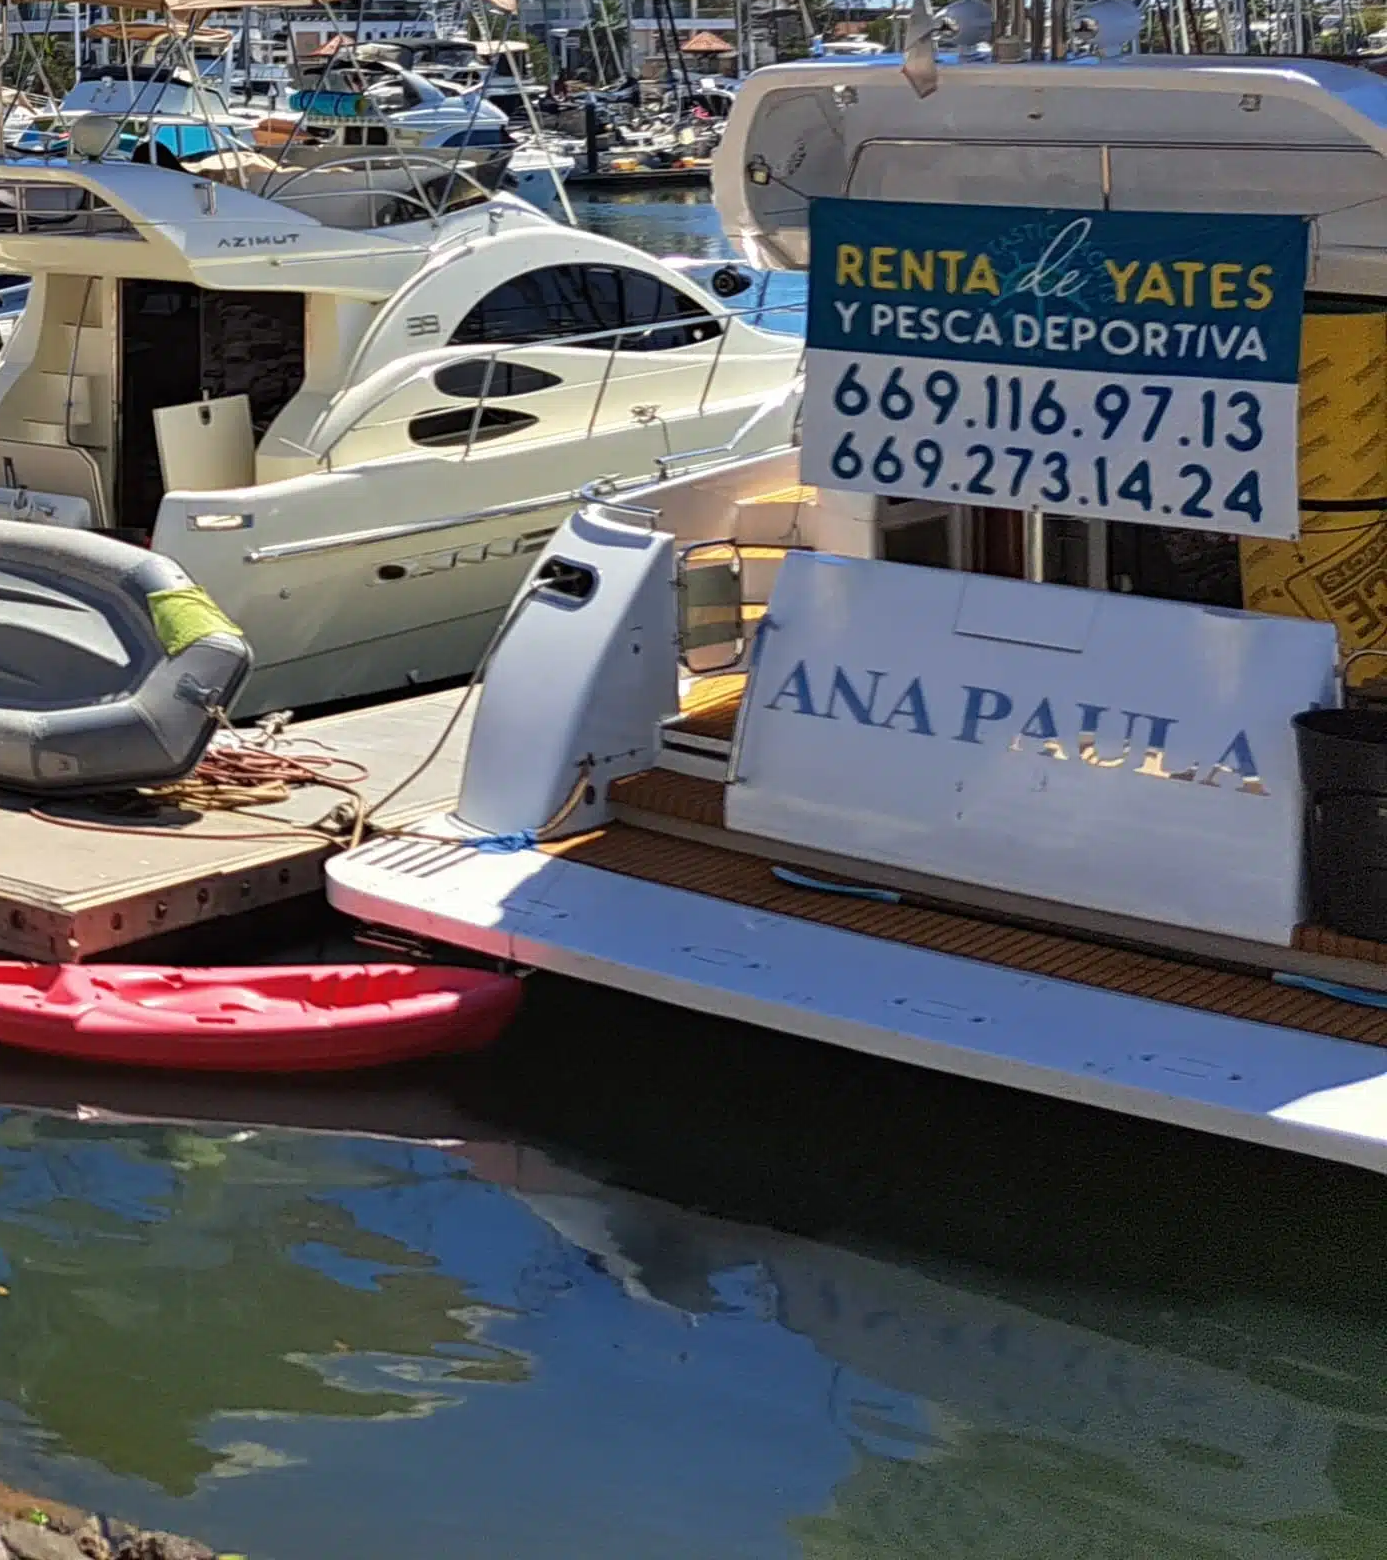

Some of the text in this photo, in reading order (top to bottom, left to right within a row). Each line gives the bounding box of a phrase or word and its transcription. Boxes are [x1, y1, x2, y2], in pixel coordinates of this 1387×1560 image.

[217, 233, 300, 249] AZIMUT
[836, 244, 1000, 297] RENTA
[1015, 216, 1093, 298] de
[1103, 258, 1274, 311] YATES
[835, 303, 1267, 362] Y PESCA DEPORTIVA
[834, 362, 1264, 452] 669.116.97.13
[831, 431, 1264, 522] 669.273.14.24
[764, 658, 1272, 798] ANA PAULA
